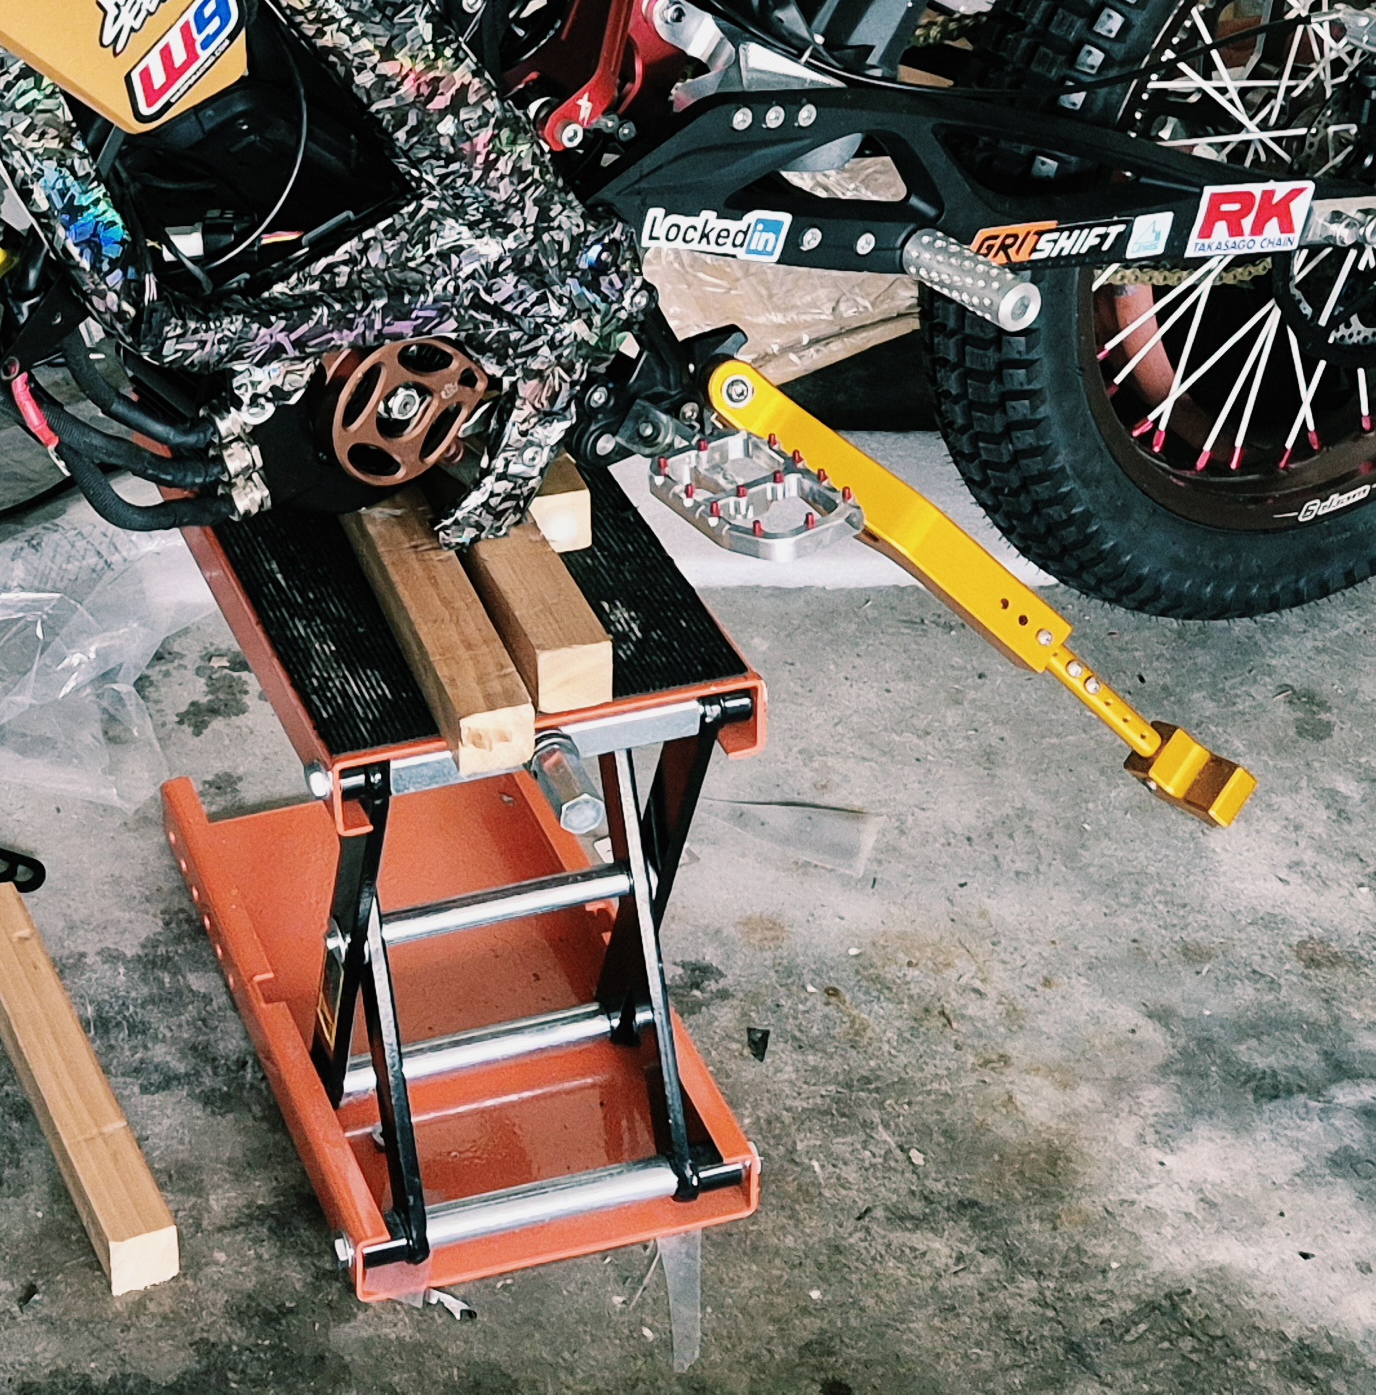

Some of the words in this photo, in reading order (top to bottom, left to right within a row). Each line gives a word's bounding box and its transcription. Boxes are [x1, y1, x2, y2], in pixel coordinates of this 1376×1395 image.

[1197, 186, 1310, 240] RK
[974, 223, 1127, 264] GRITSHIFT
[1193, 238, 1256, 253] TAKASAGO
[1260, 236, 1295, 250] CHAIN
